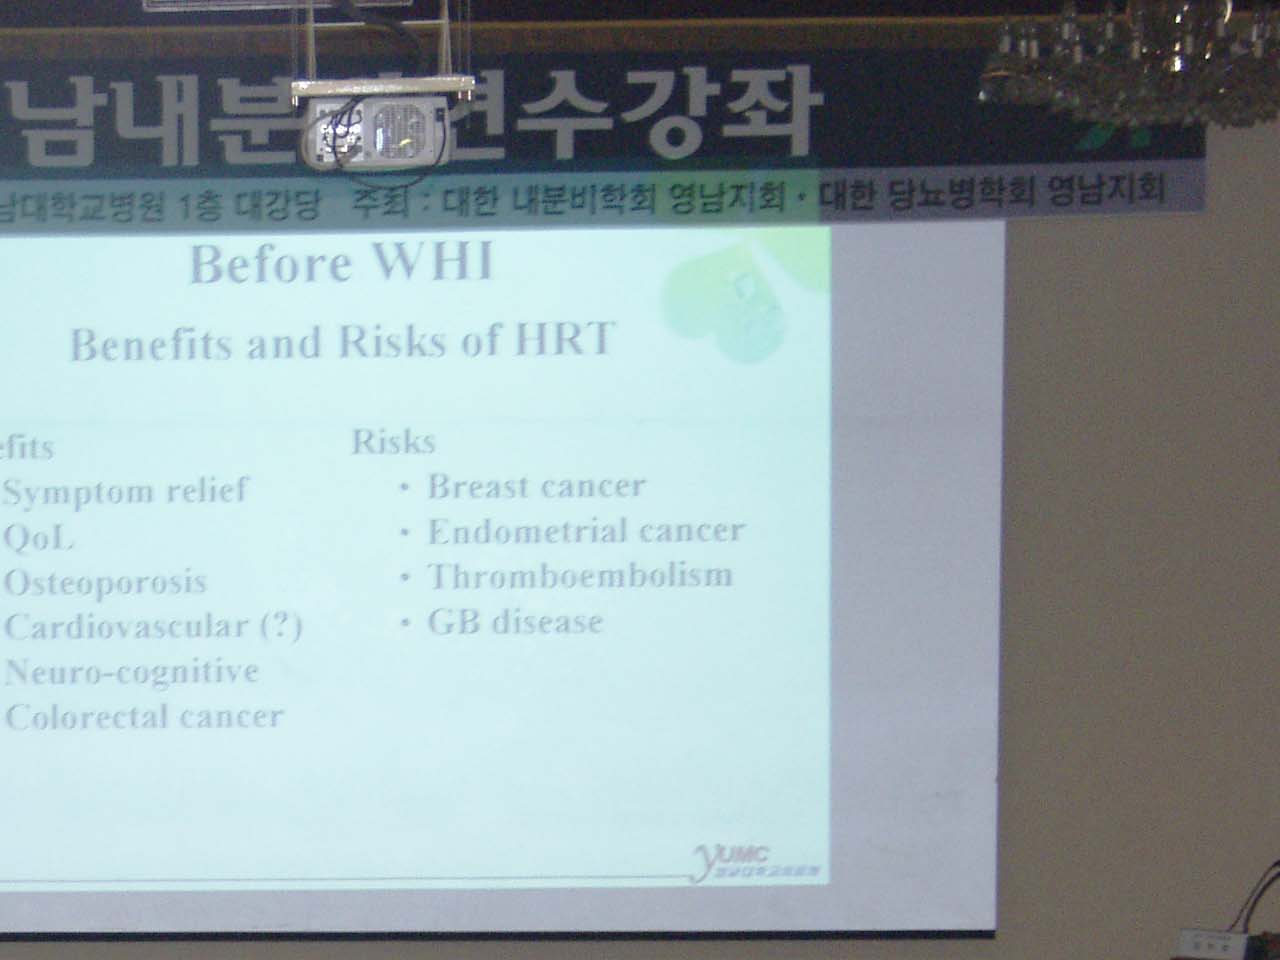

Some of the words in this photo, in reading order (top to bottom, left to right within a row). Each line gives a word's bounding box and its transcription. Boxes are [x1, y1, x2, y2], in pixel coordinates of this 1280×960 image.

[179, 189, 225, 224] 1층
[234, 187, 322, 223] 대강당
[440, 183, 501, 217] 대한
[512, 182, 657, 217] 내분비학회
[668, 179, 786, 216] 영남지회
[818, 178, 879, 212] 대한
[888, 174, 1036, 211] 당뇨병학회
[1047, 170, 1167, 208] 영남지회
[190, 243, 353, 284] Before
[371, 240, 494, 281] WHI
[70, 326, 233, 362] Benefits
[247, 325, 321, 360] and
[339, 323, 446, 358] Risks
[461, 322, 504, 357] of
[514, 321, 617, 356] HRT
[352, 428, 436, 456] Risks
[2, 478, 153, 513] Symptom
[167, 475, 251, 504] relief
[428, 472, 529, 499] Breast
[541, 478, 648, 499] cancer
[3, 523, 75, 555] QoL
[428, 517, 628, 546] Endometrial
[639, 523, 747, 544] cancer
[3, 567, 208, 603] Osteoporosis
[428, 560, 733, 590] Thromboembolism
[4, 611, 250, 641] Cardiovascular
[260, 610, 304, 643] (?)
[428, 607, 481, 636] GB
[492, 607, 604, 635] disease
[5, 656, 260, 689] Neuro-cognitive
[4, 702, 169, 731] Colorectal
[179, 708, 286, 730] cancer
